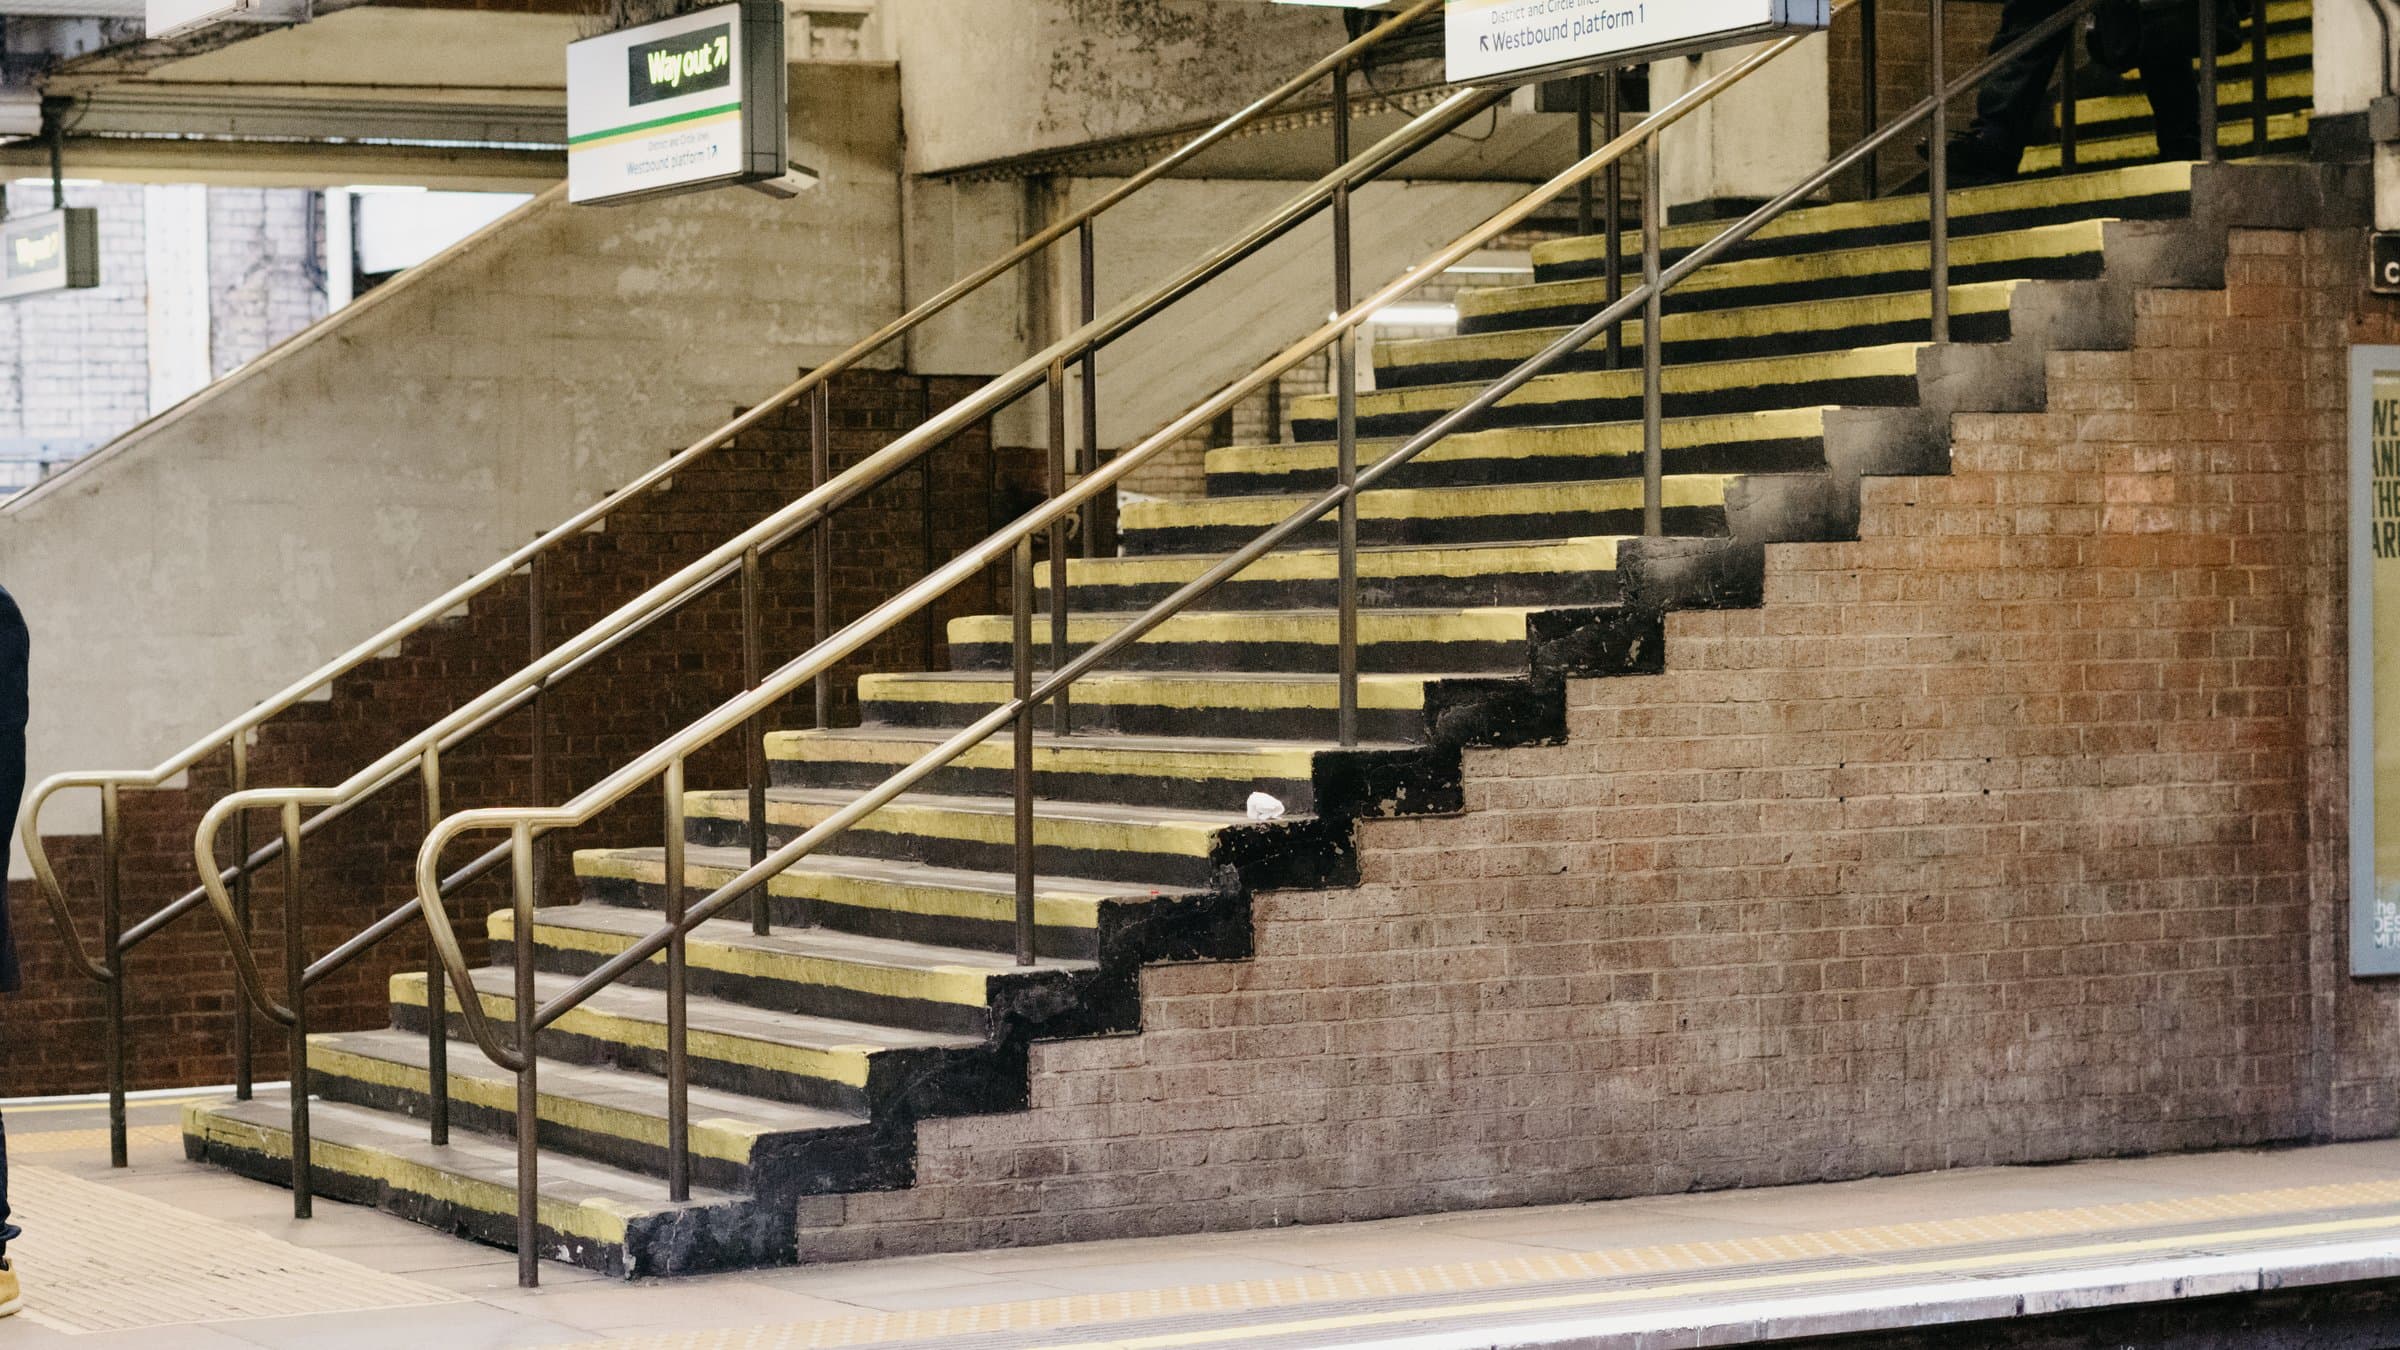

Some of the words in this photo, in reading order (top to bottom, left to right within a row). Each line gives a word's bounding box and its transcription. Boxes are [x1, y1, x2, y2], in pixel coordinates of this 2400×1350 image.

[1491, 7, 1525, 24] District
[1528, 4, 1544, 17] and
[1547, 0, 1574, 13] Circle
[1492, 18, 1568, 52] Westbound
[1573, 10, 1634, 41] platform
[1638, 3, 1644, 23] 1
[648, 50, 682, 87] Way
[683, 43, 712, 77] out
[625, 156, 668, 176] Westbound
[671, 148, 704, 168] platform
[2374, 899, 2396, 915] he
